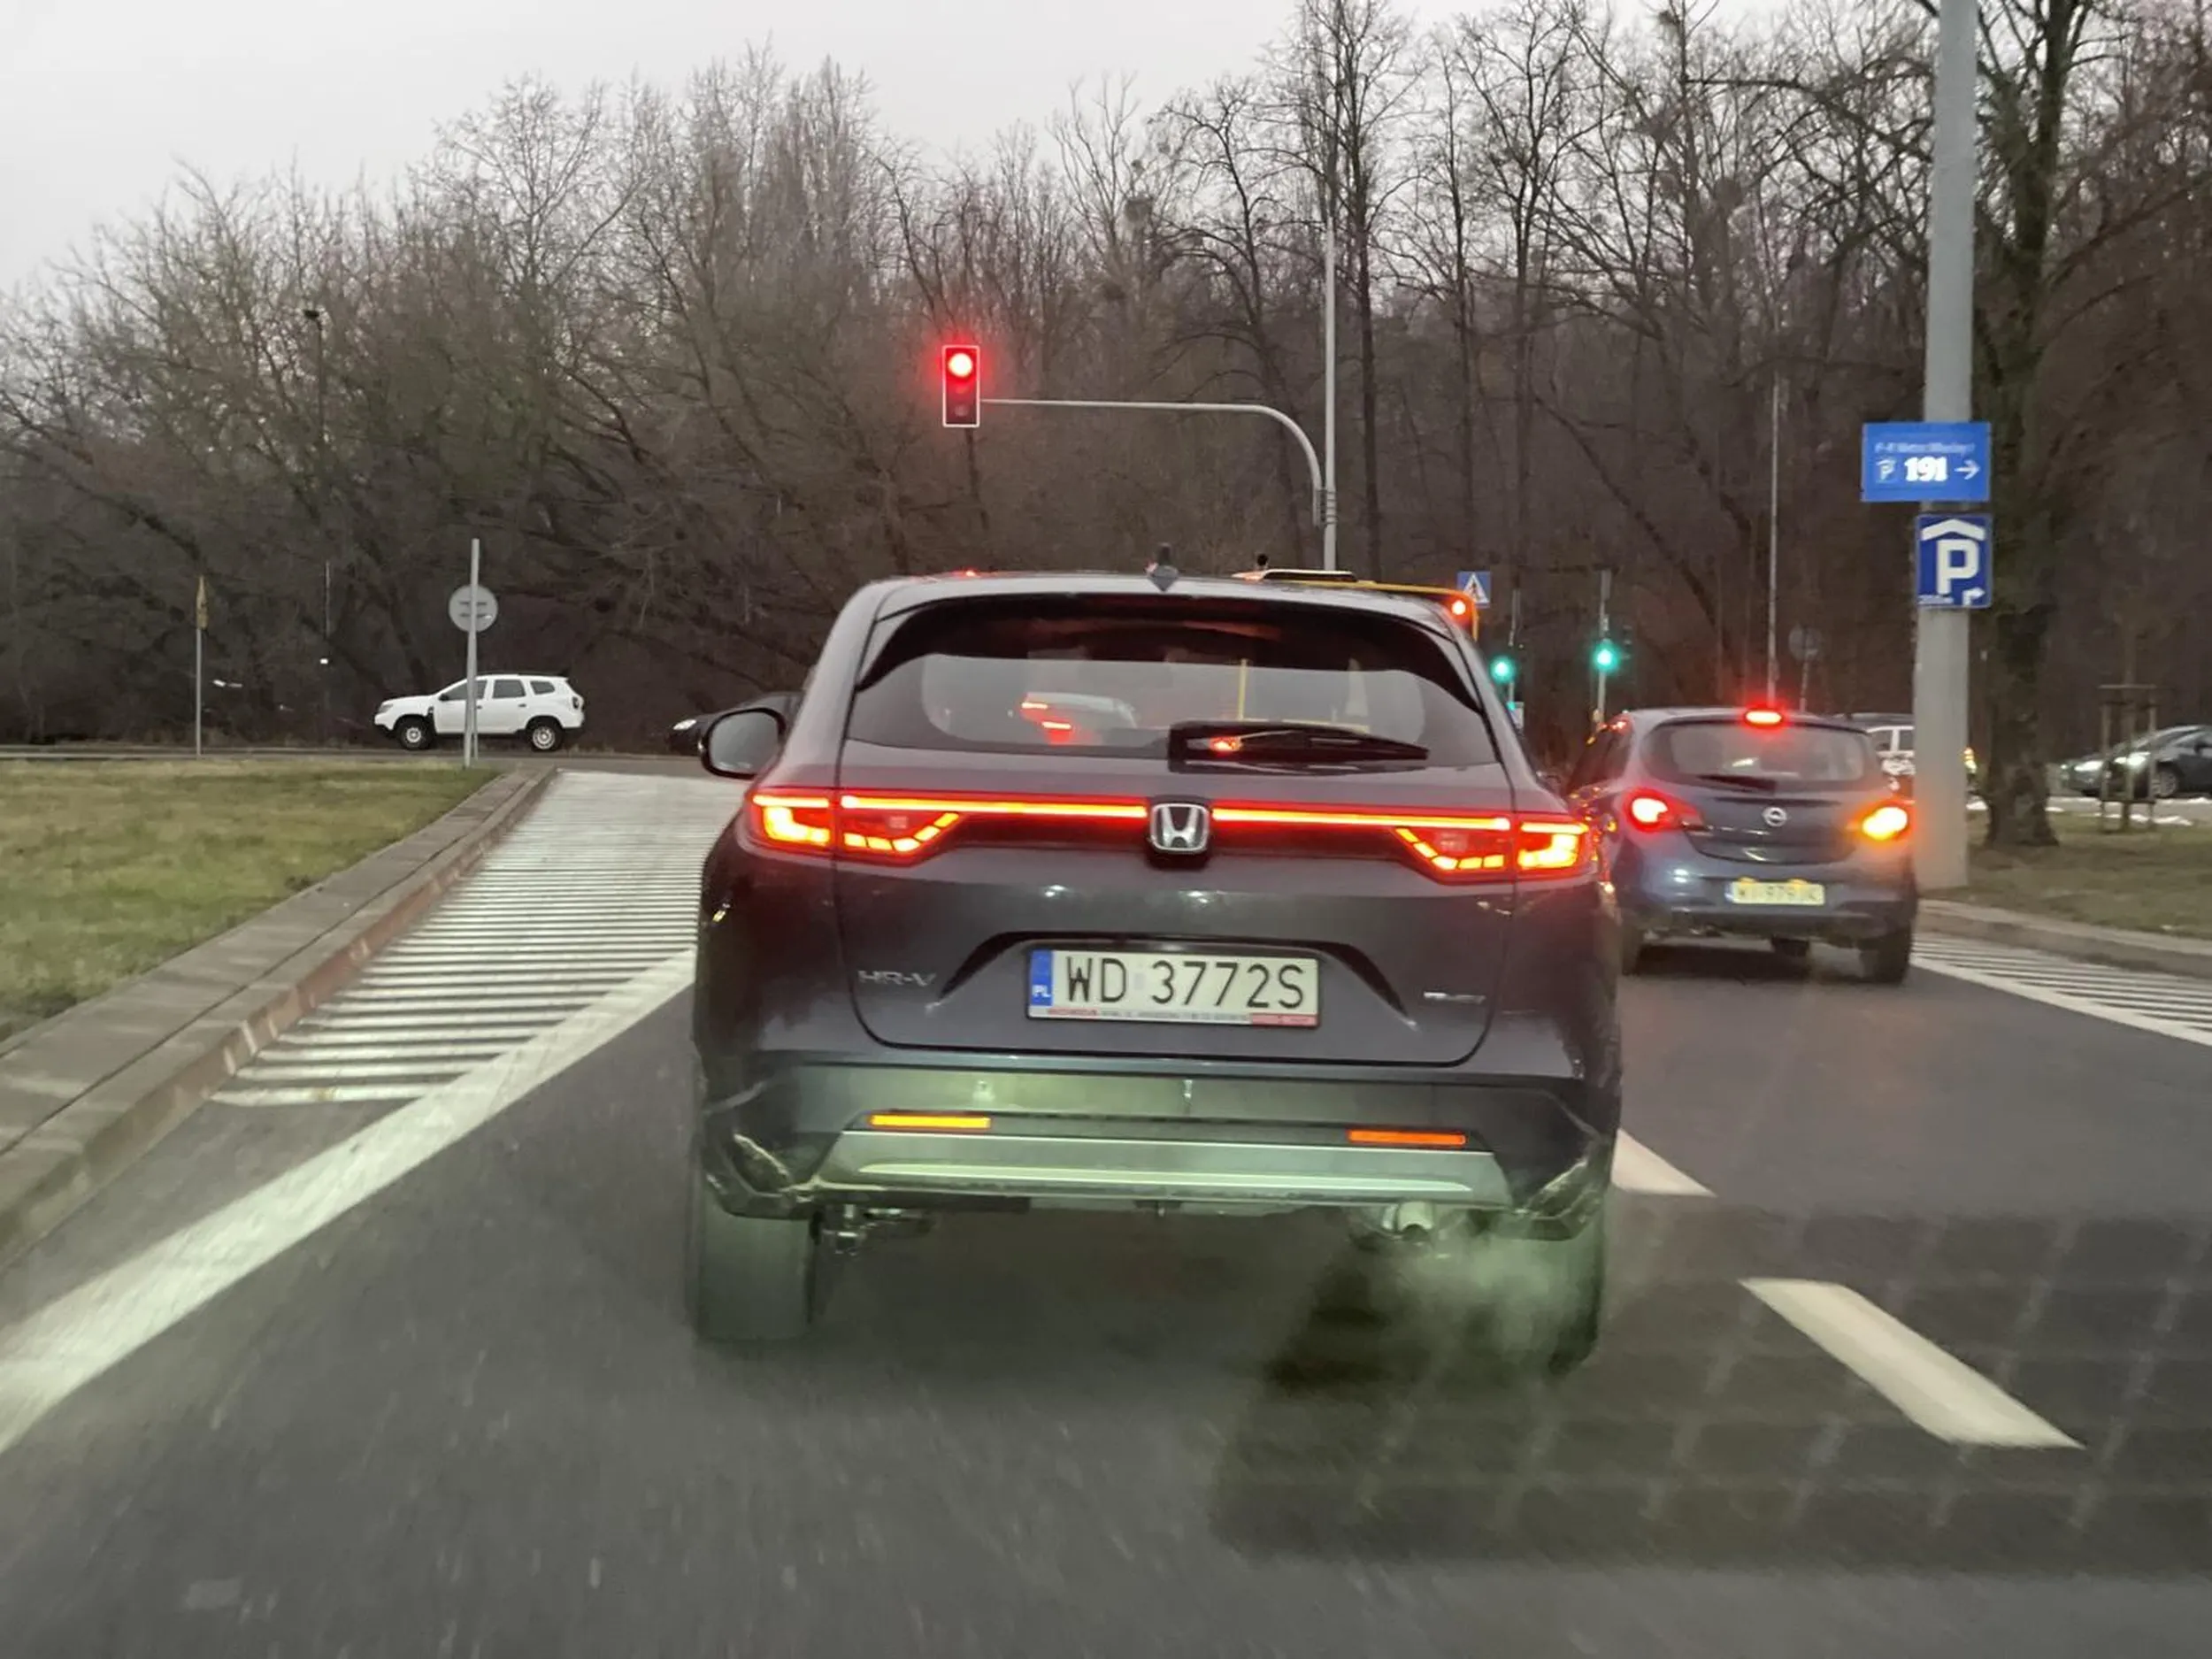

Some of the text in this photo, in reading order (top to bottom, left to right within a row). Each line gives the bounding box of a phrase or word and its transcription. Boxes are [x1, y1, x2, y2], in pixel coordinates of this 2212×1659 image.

[1904, 457, 1947, 481] 191
[1937, 539, 1979, 594] P
[857, 970, 936, 987] HR-V
[1067, 956, 1303, 1009] WD 3772S
[1032, 985, 1051, 998] PL
